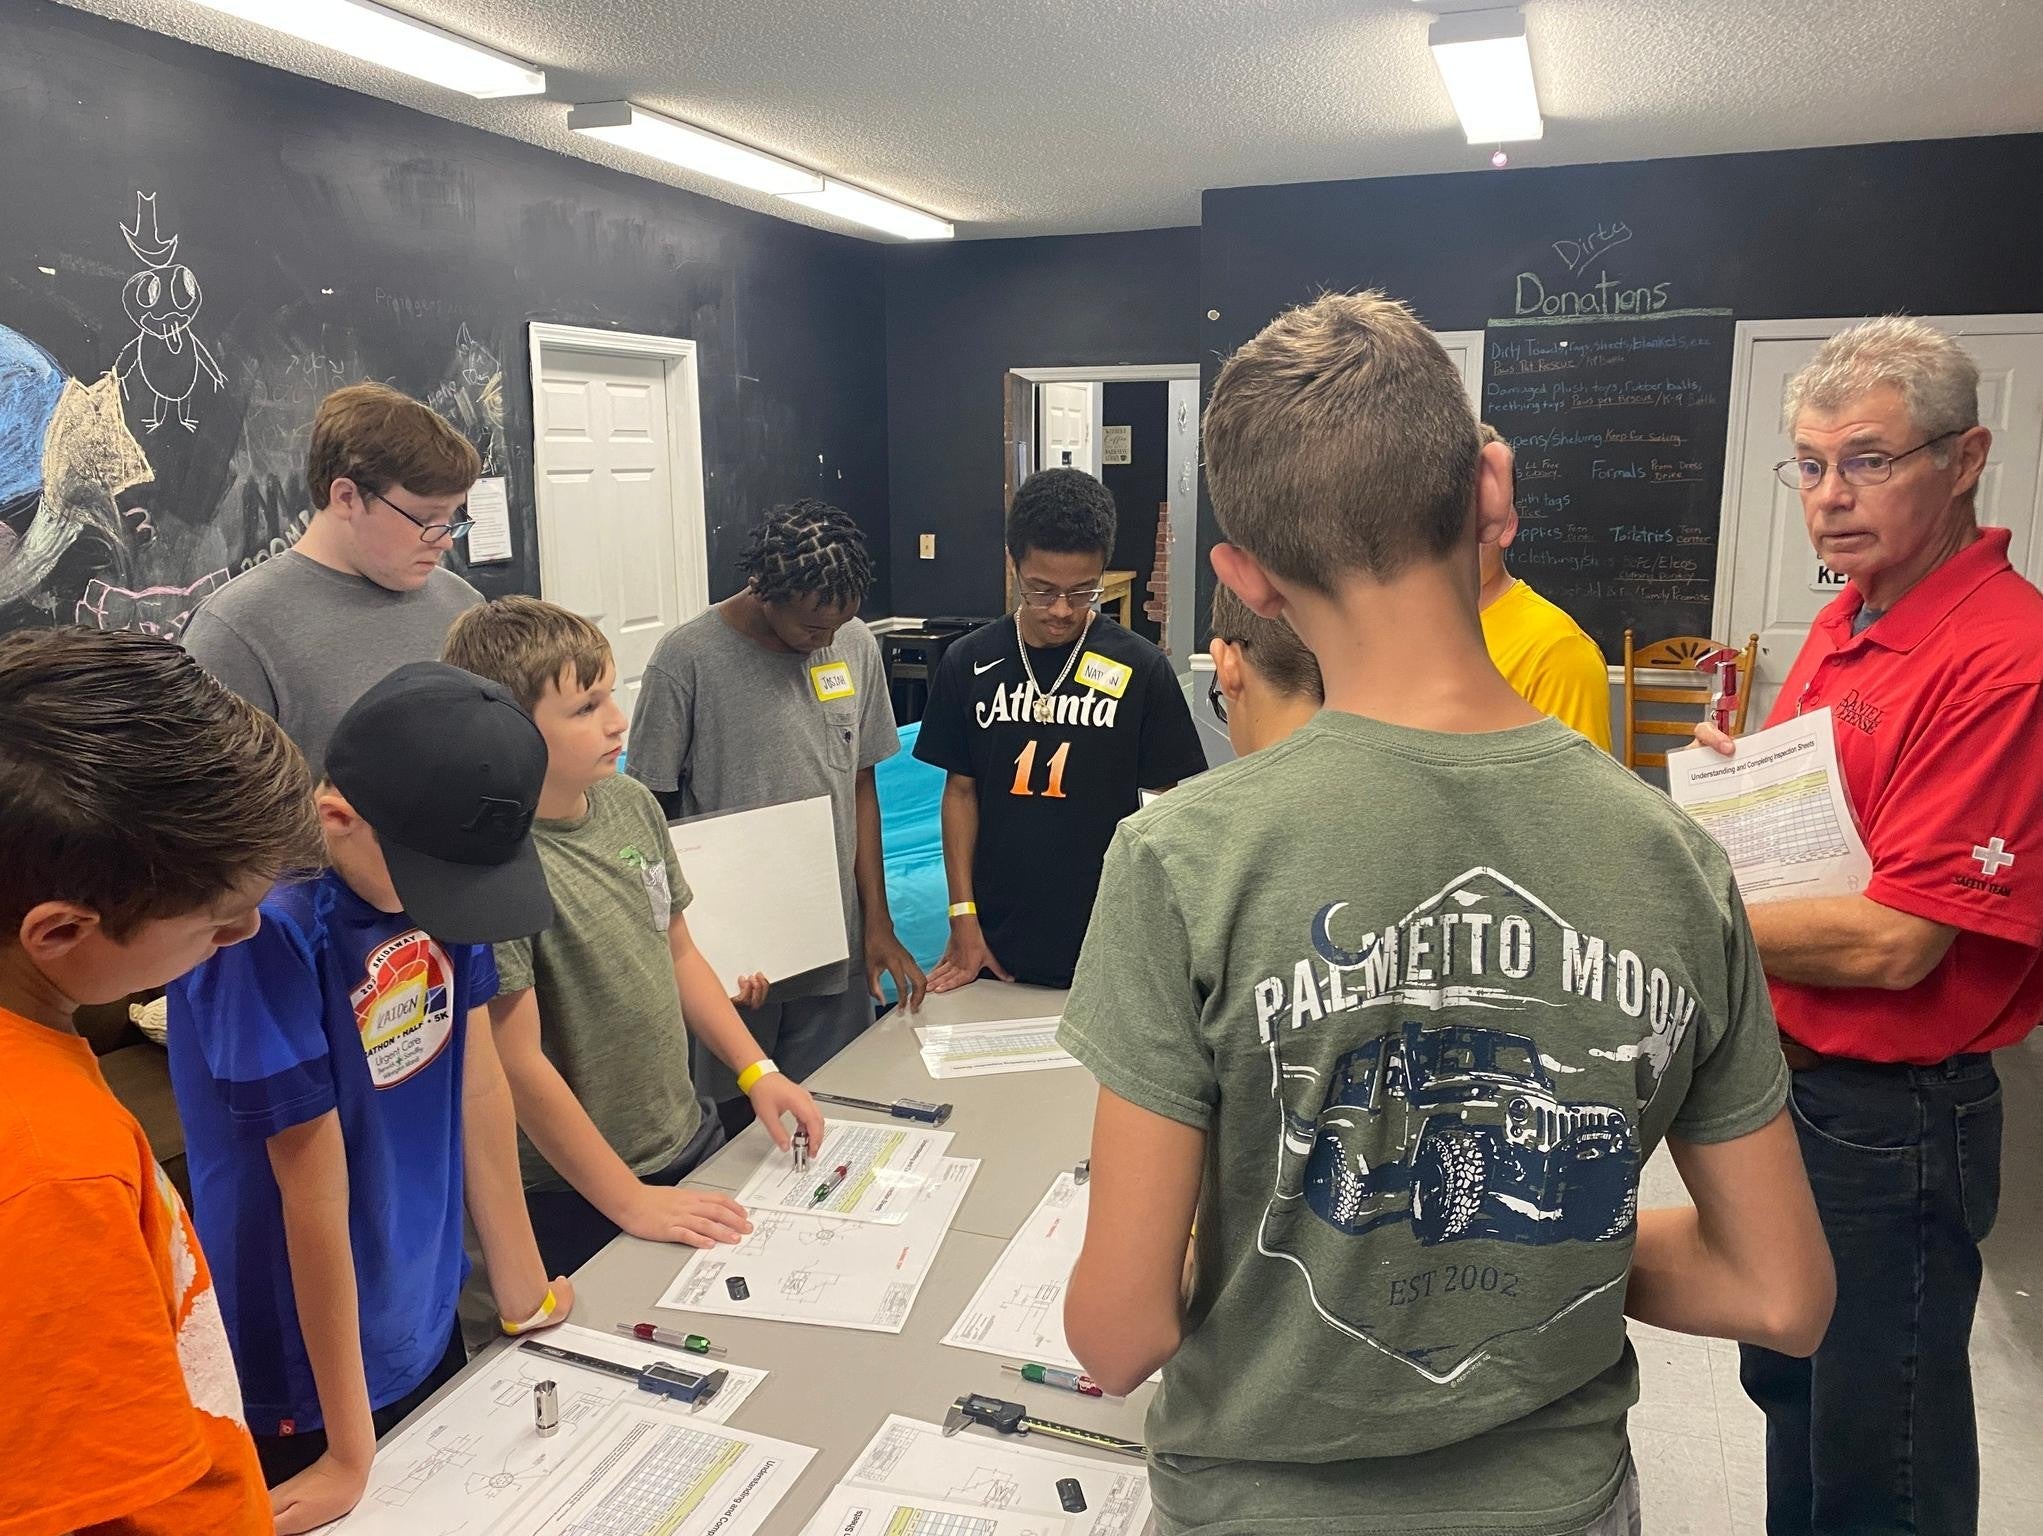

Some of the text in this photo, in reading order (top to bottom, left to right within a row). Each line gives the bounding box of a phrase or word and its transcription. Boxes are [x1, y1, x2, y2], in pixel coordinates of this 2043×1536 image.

[1552, 221, 1633, 277] Dirty
[1514, 270, 1671, 316] Donations
[1491, 340, 1521, 361] Dirty
[1487, 382, 1547, 402] Damaged
[1552, 380, 1588, 401] plush
[1592, 459, 1646, 480] Formals
[1543, 491, 1570, 511] tags
[1608, 523, 1674, 545] Toiletries
[1835, 697, 1883, 736] DEFENSE
[1845, 688, 1885, 723] DANIEL
[1009, 740, 1071, 798] 11
[1690, 765, 1736, 781] Understanding
[1736, 762, 1748, 772] and
[1747, 754, 1774, 769] Completing
[1797, 739, 1816, 751] Sheets
[373, 934, 417, 969] SKIDAWAY
[1254, 913, 1535, 1045] PALMETTO
[376, 994, 419, 1030] KAIDEN
[402, 1022, 424, 1037] HALF
[434, 1010, 449, 1023] 5K
[375, 1037, 422, 1067] Urgent Care
[1389, 1264, 1520, 1306] EST 2002
[733, 1460, 777, 1504] Understanding
[724, 1503, 738, 1517] and
[844, 1510, 864, 1533] Sheets
